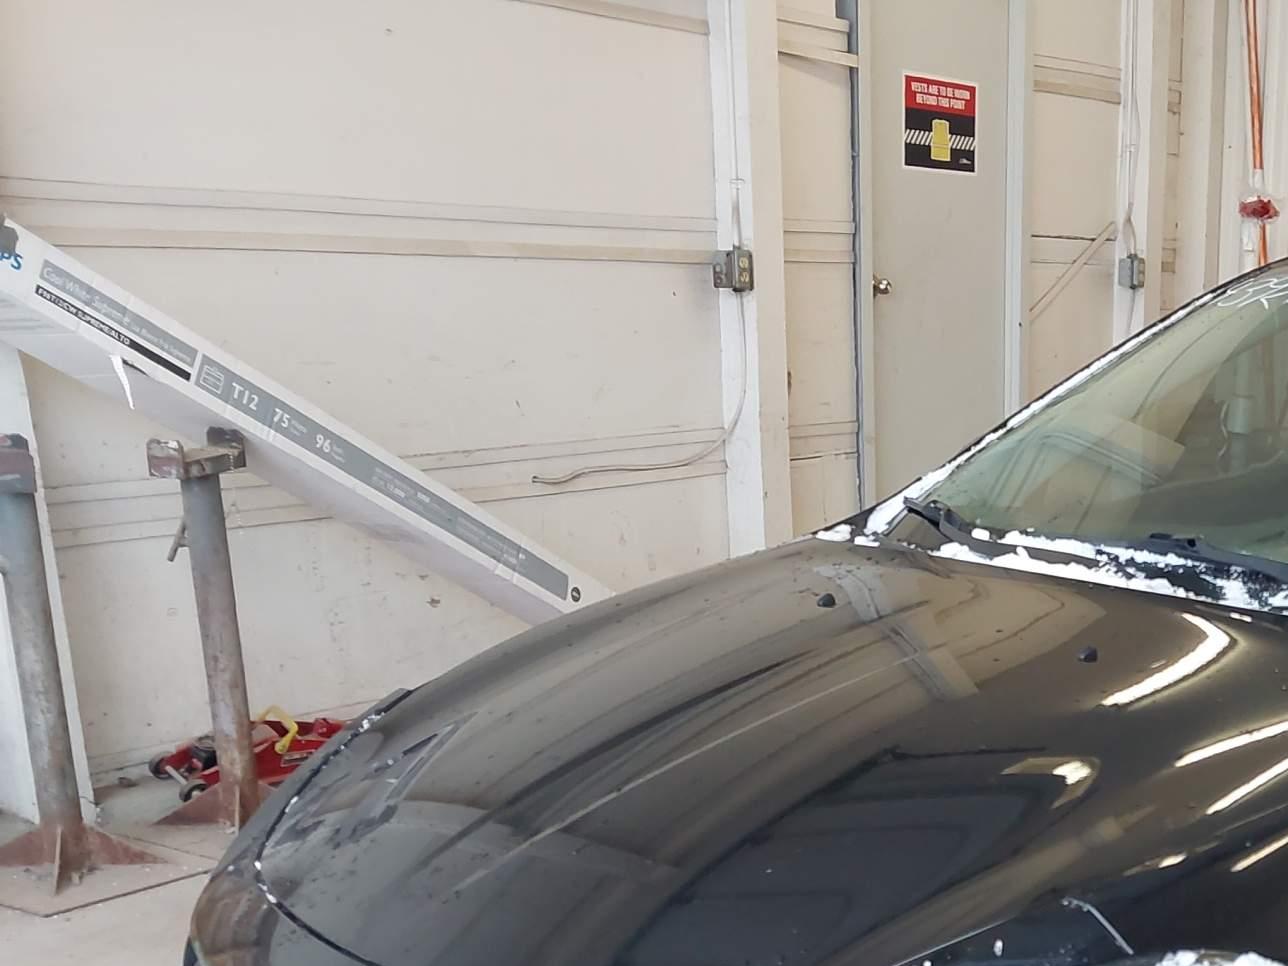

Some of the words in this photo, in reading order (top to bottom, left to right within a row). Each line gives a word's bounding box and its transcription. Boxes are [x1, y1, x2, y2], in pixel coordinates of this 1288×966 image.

[231, 382, 260, 411] T12
[273, 408, 291, 428] 75
[315, 434, 332, 453] 96
